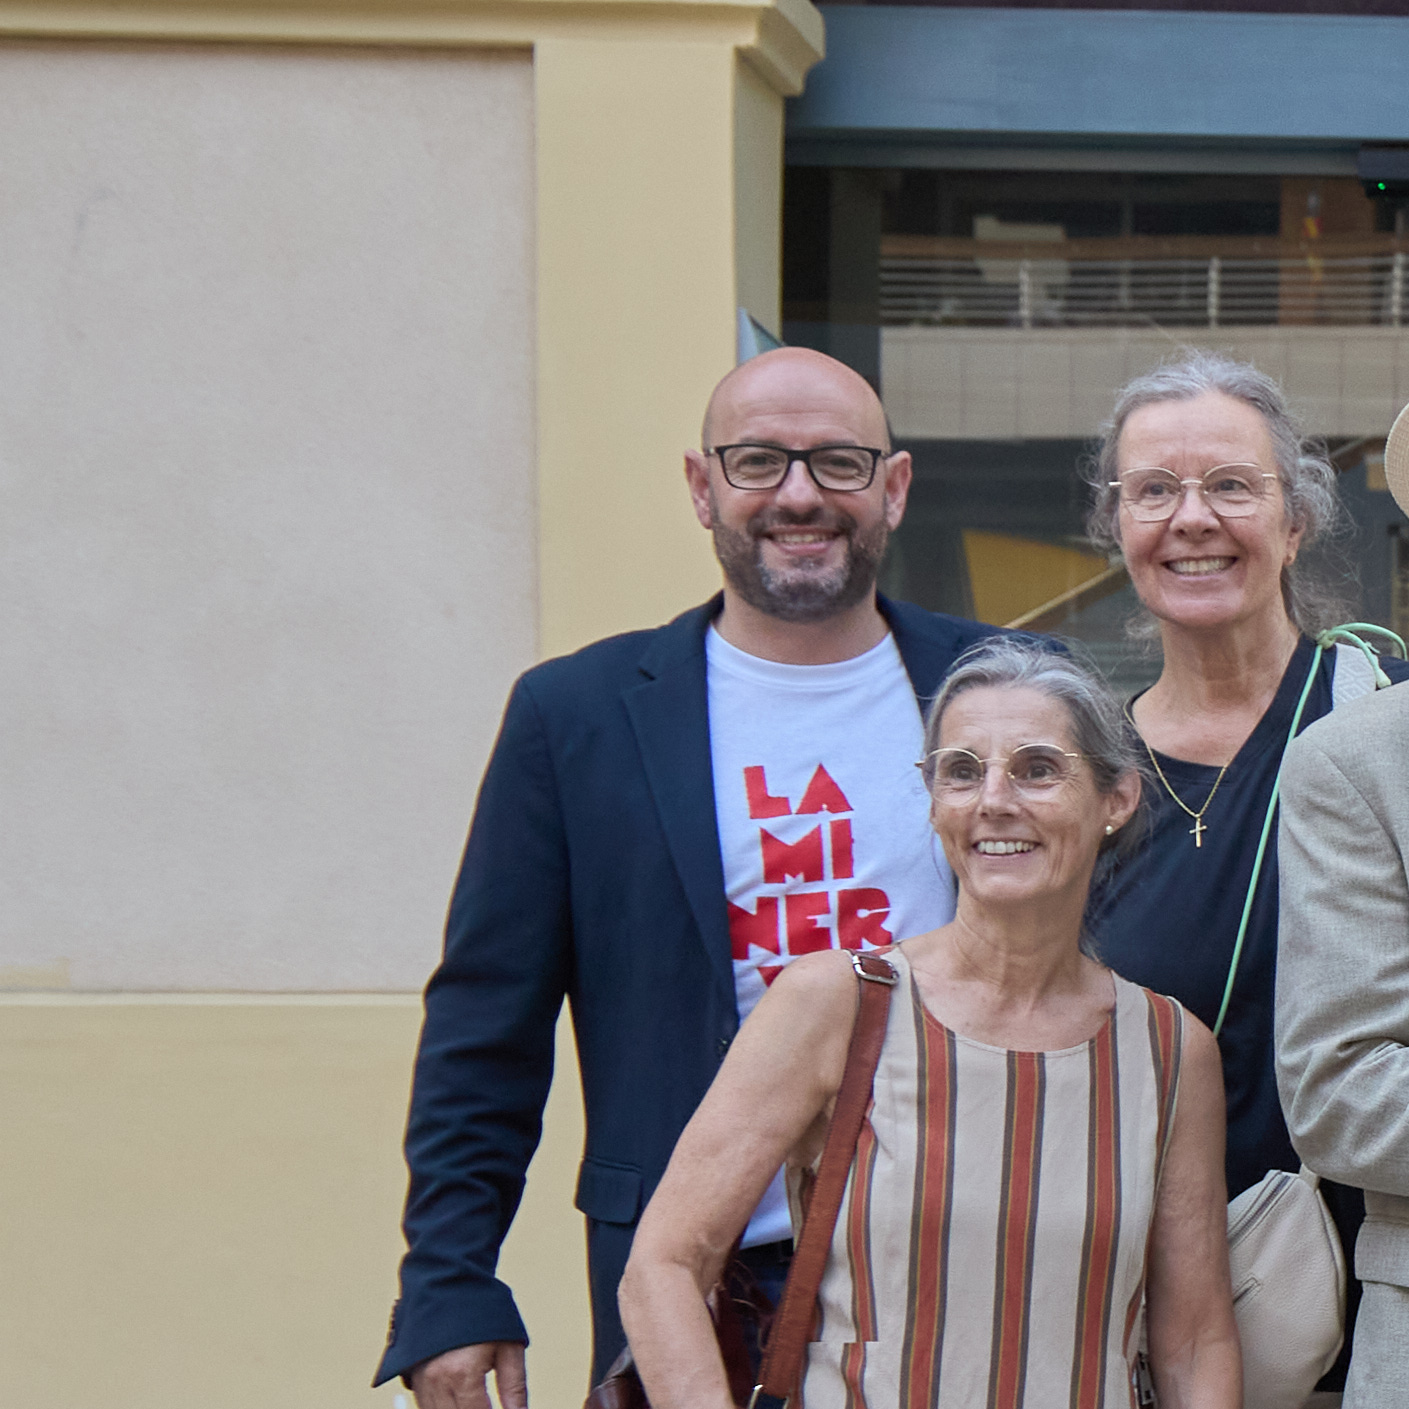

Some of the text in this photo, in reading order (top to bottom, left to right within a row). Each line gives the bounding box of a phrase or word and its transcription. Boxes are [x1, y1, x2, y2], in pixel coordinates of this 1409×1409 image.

[743, 762, 854, 820] LA
[759, 818, 854, 884] MI
[727, 886, 893, 960] NER
